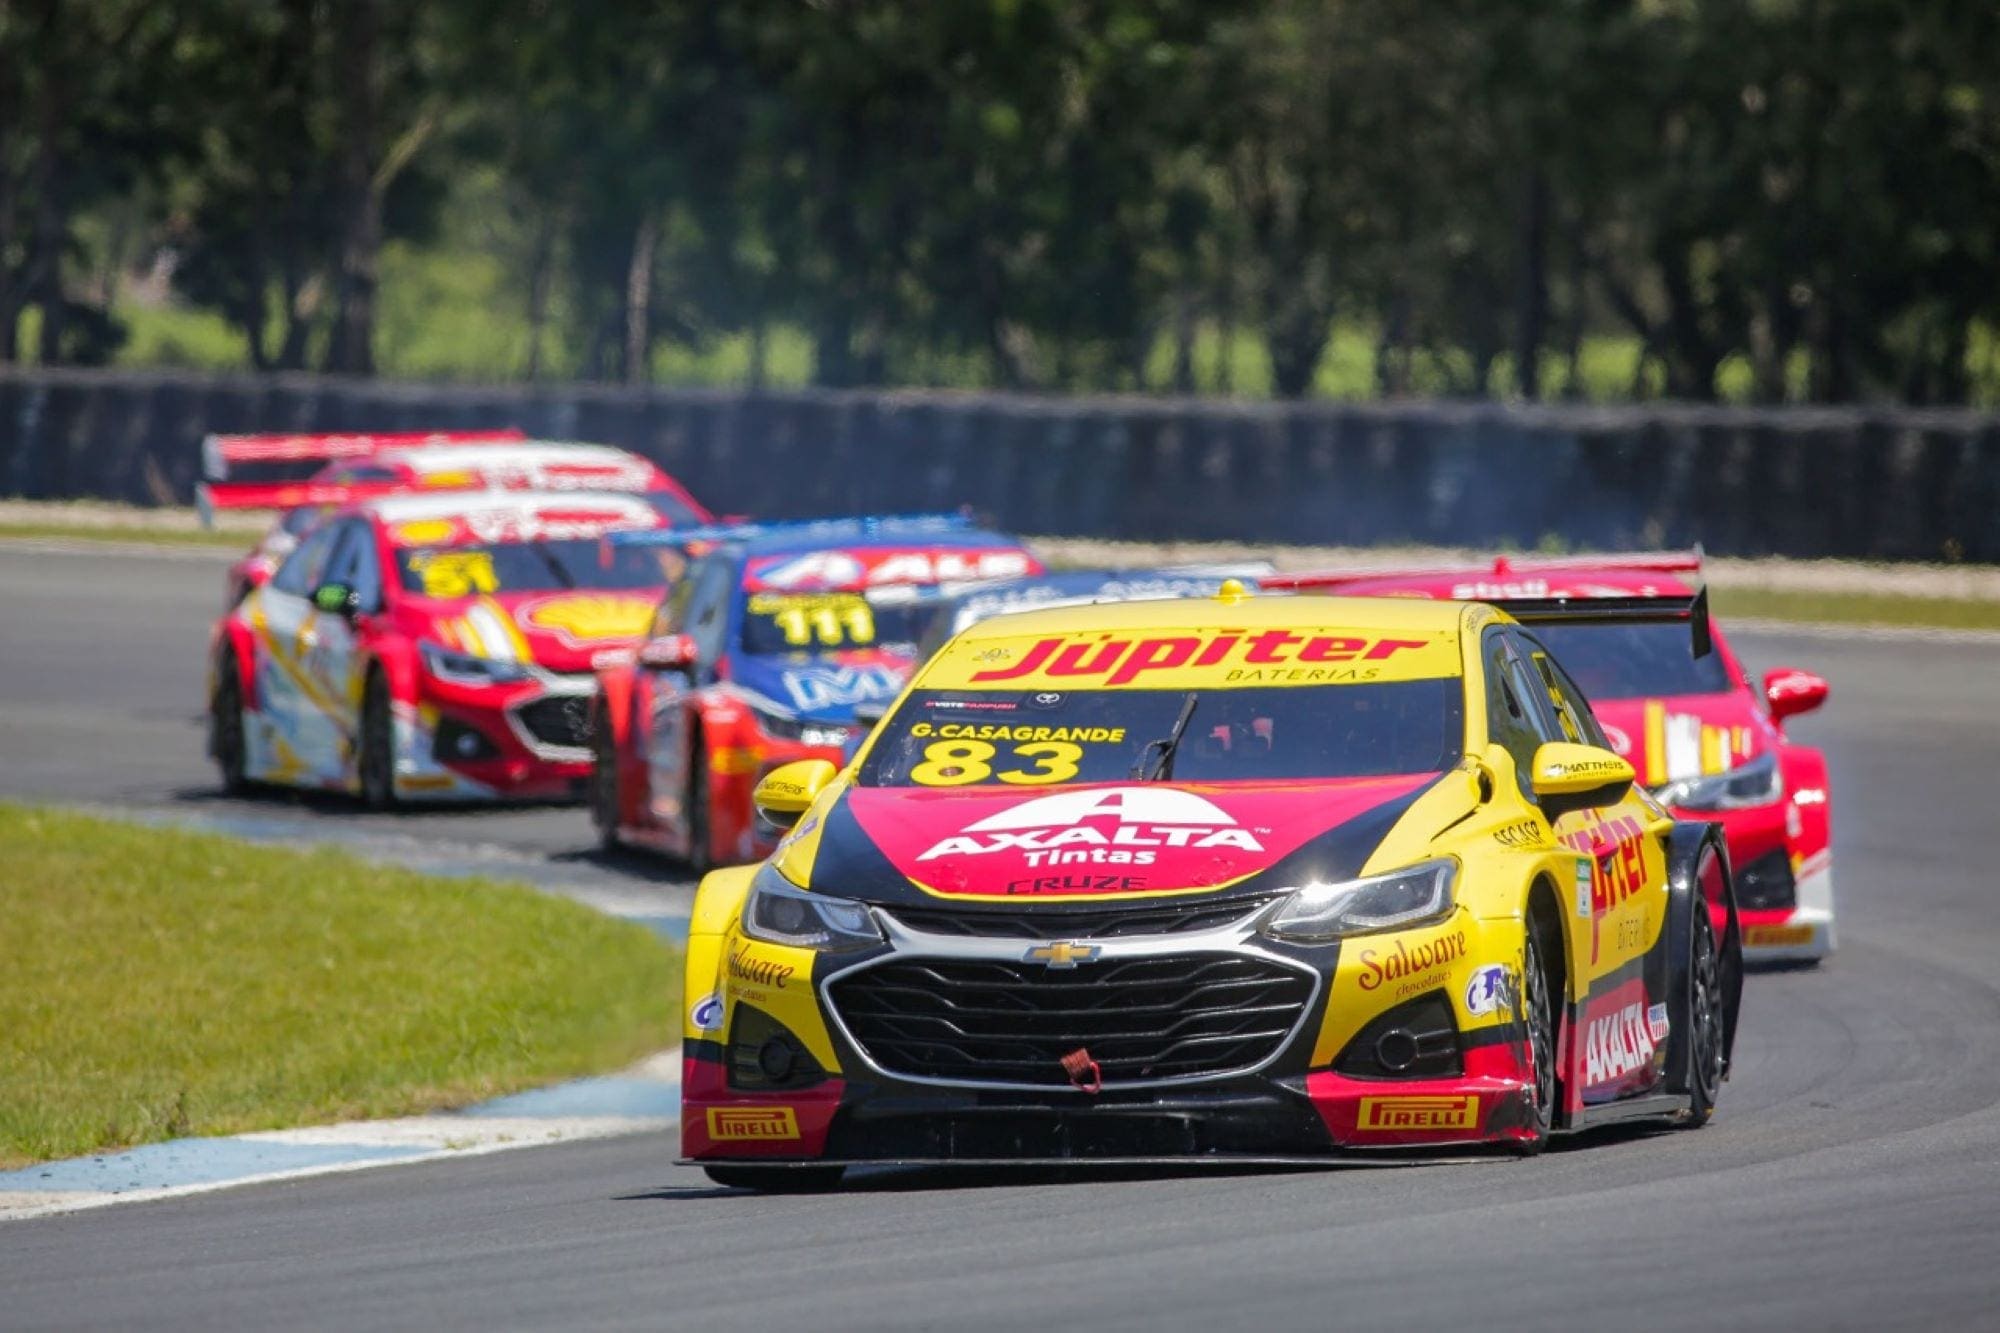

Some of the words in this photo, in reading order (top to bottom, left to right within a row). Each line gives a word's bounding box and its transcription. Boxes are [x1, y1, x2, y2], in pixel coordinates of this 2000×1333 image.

[776, 604, 875, 645] 111
[969, 629, 1430, 687] Júpiter
[1225, 668, 1380, 682] BATERIAS
[911, 722, 1127, 743] G.CASAGRANDE
[910, 739, 1084, 786] 83
[915, 826, 1266, 863] AXALTA
[1024, 847, 1157, 868] Tintas
[1007, 875, 1148, 896] CRUZE
[1358, 930, 1467, 991] Salware
[714, 1111, 789, 1137] PIRELLI
[1369, 1101, 1467, 1126] PIRELLI
